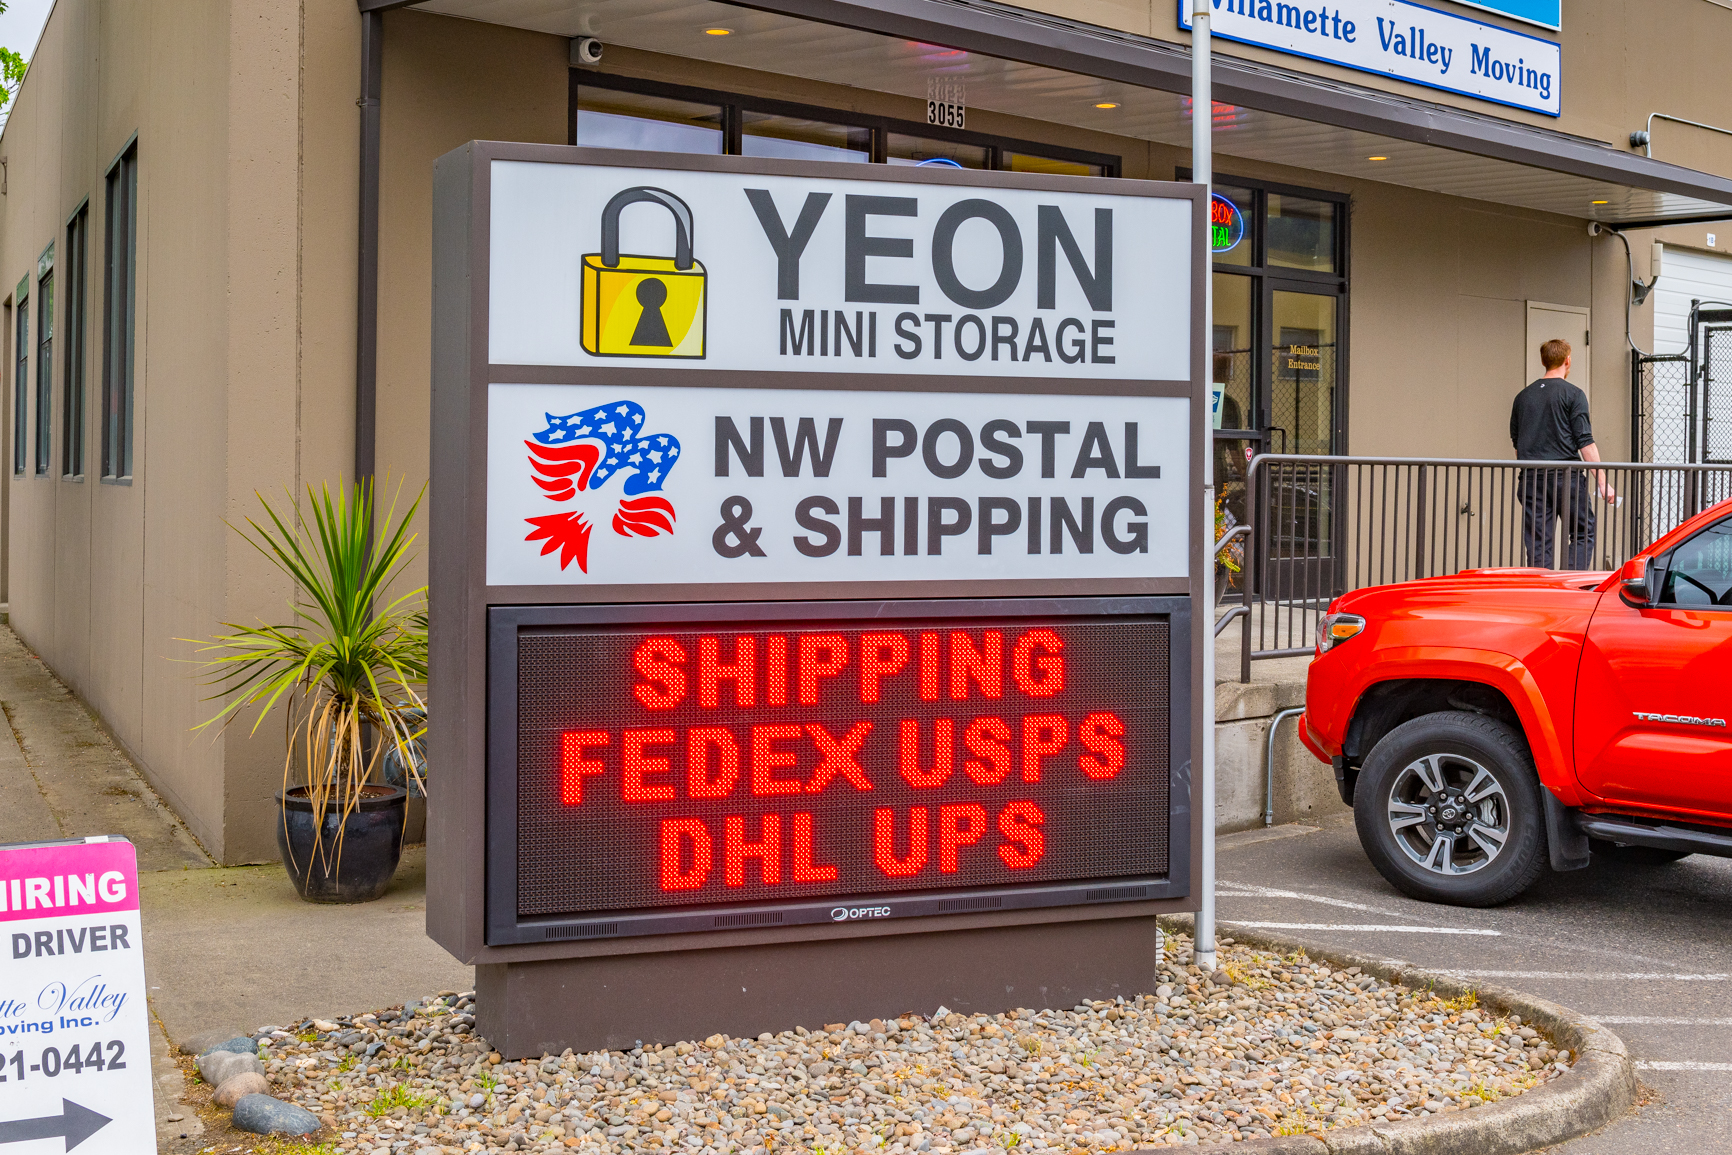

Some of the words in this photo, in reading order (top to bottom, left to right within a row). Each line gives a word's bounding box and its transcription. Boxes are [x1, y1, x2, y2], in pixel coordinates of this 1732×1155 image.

[1376, 16, 1453, 74] Valley
[1470, 43, 1551, 100] Moving
[928, 101, 964, 128] 3055
[743, 188, 1113, 312] YEON
[779, 308, 877, 358] MINI
[894, 311, 1116, 364] STORAGE
[1289, 344, 1319, 356] Mailbox
[1287, 358, 1321, 370] Entrance
[714, 416, 844, 478] NW
[872, 418, 1161, 480] POSTAL
[711, 495, 767, 558] &
[792, 495, 1149, 557] SHIPPING
[632, 628, 1066, 710] SHIPPING
[1632, 711, 1727, 727] TACOMA
[560, 721, 875, 805] FEDEX
[899, 710, 1127, 789] USPS
[659, 812, 839, 892] DHL
[874, 800, 1047, 878] UPS
[0, 870, 127, 912] IRING
[849, 906, 891, 919] OPTEC
[11, 924, 131, 960] DRIVER
[37, 974, 130, 1023] Valley
[60, 1016, 100, 1029] Inc.
